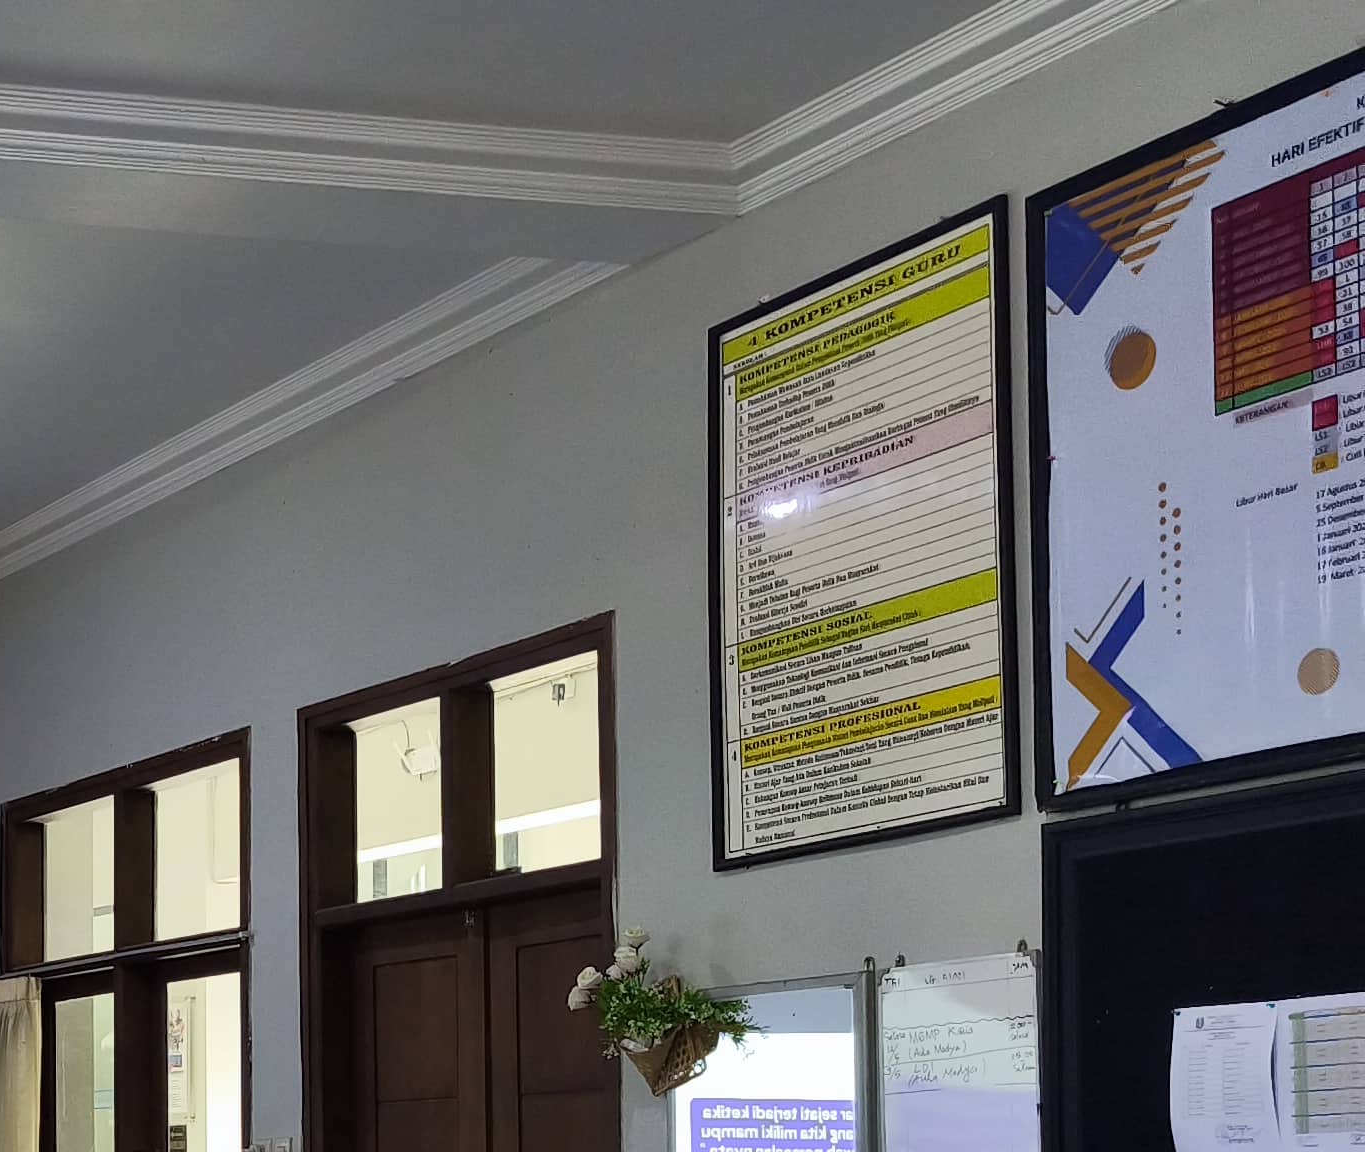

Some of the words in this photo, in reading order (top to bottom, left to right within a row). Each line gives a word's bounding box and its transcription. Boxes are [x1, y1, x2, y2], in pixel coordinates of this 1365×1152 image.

[1271, 141, 1304, 167] HARI
[765, 272, 894, 342] KOMPETENSI
[901, 243, 961, 282] GURU
[739, 342, 818, 385] KOMPETENSI
[823, 434, 913, 477] KEPRIBADIAN
[741, 623, 822, 656] KOMPETENSI
[826, 608, 872, 632] SOSIAL
[744, 724, 824, 752] KOMPETENSI
[829, 700, 920, 731] PROFESIONAL
